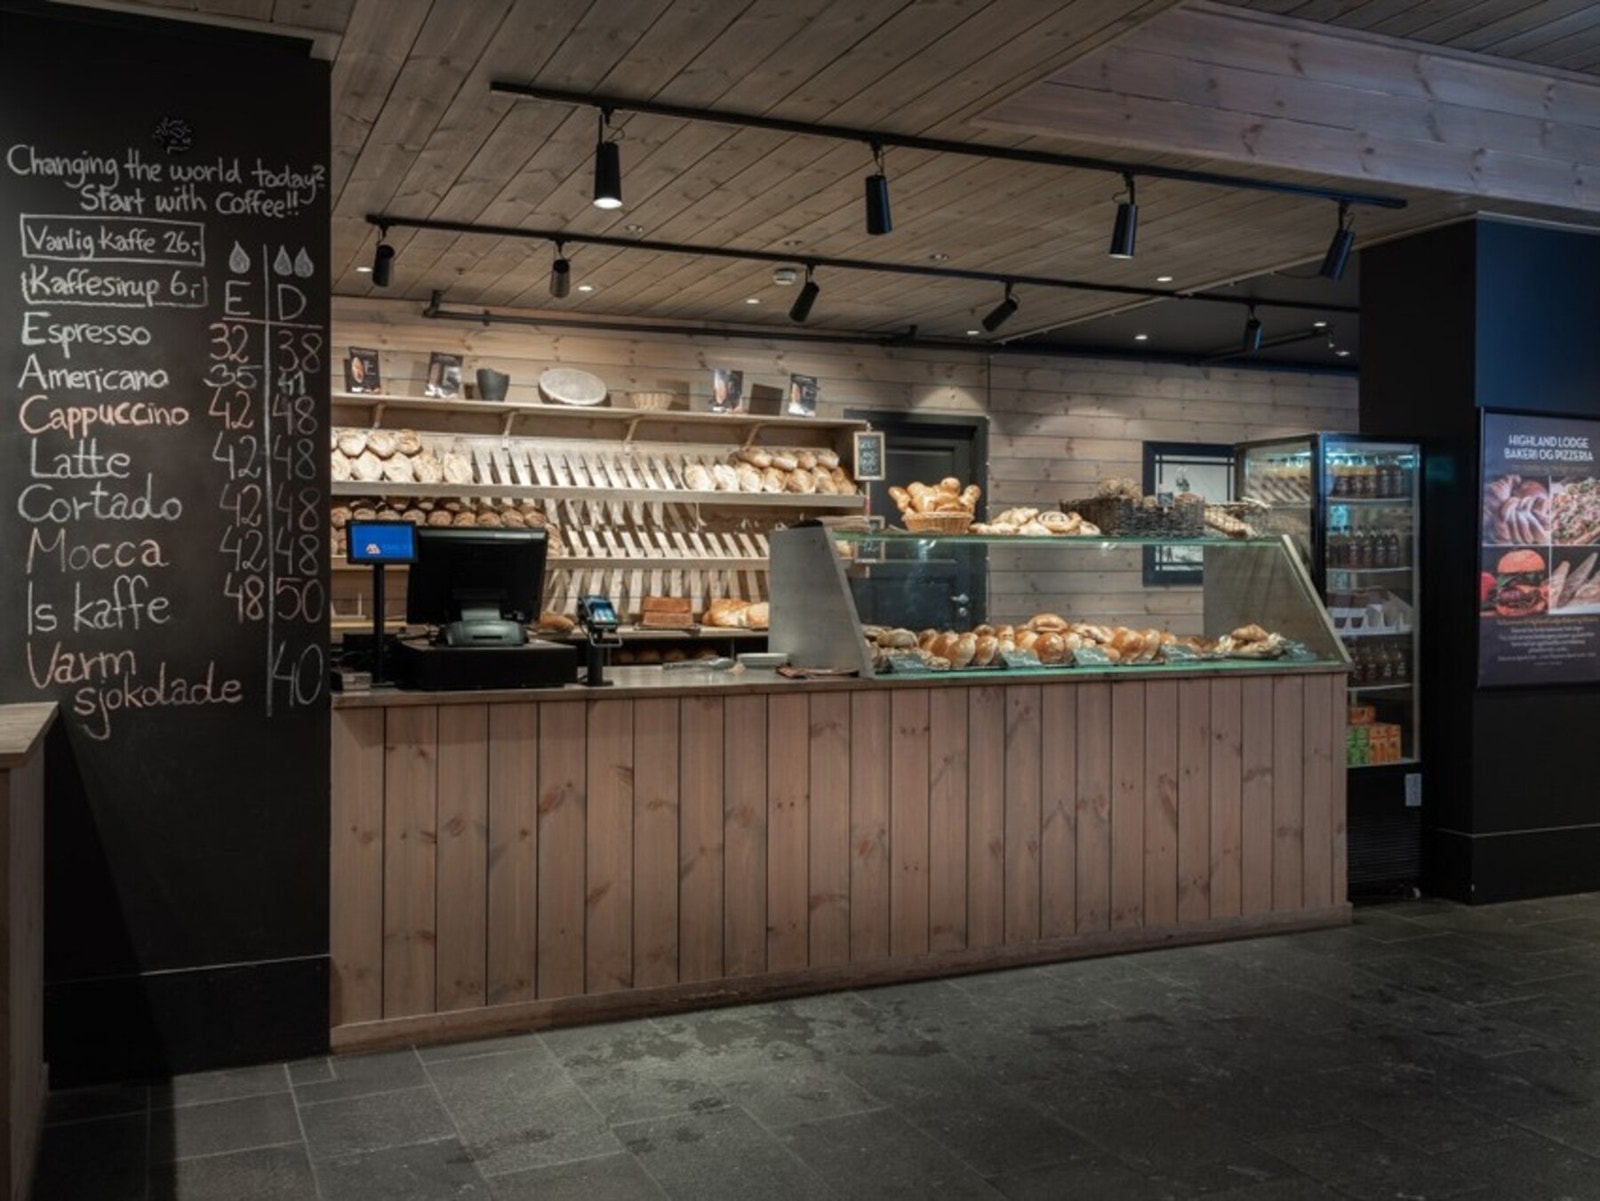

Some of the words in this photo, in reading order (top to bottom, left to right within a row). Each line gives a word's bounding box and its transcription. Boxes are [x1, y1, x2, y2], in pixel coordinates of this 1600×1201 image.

[7, 144, 119, 188] Changing
[124, 147, 163, 183] the
[170, 157, 242, 184] world
[250, 158, 326, 204] today?
[80, 185, 146, 215] Start
[154, 185, 207, 212] with
[26, 225, 95, 258] Vanlig
[30, 263, 161, 308] Kaffesirup
[224, 280, 252, 317] E
[276, 283, 307, 321] D
[21, 311, 152, 359] Espresso
[208, 322, 250, 364] 32
[276, 330, 323, 374] 38
[17, 353, 170, 396] Americano
[202, 363, 263, 390] 35
[18, 394, 190, 439] Cappuccino
[208, 387, 254, 430] 42
[272, 393, 319, 436] 48
[29, 437, 131, 480] Latte
[212, 431, 262, 481] 42
[272, 434, 318, 481] 48
[1504, 448, 1538, 460] BAKERI
[1539, 449, 1554, 461] OG
[1555, 450, 1594, 462] PIZZERIA
[1508, 434, 1557, 447] HIGHLAND
[1558, 436, 1590, 449] LODGE
[17, 473, 184, 524] Cortado
[219, 482, 263, 529] 42
[275, 482, 321, 533] 48
[26, 527, 170, 575] Mocca
[219, 526, 267, 573] 42
[274, 527, 320, 577] 48
[27, 580, 58, 636] Is
[73, 574, 171, 633] kaffe
[223, 572, 266, 624] 48
[275, 576, 325, 624] 50
[26, 641, 137, 690] Varm
[271, 639, 325, 708] 40
[73, 661, 244, 741] sjokolade
